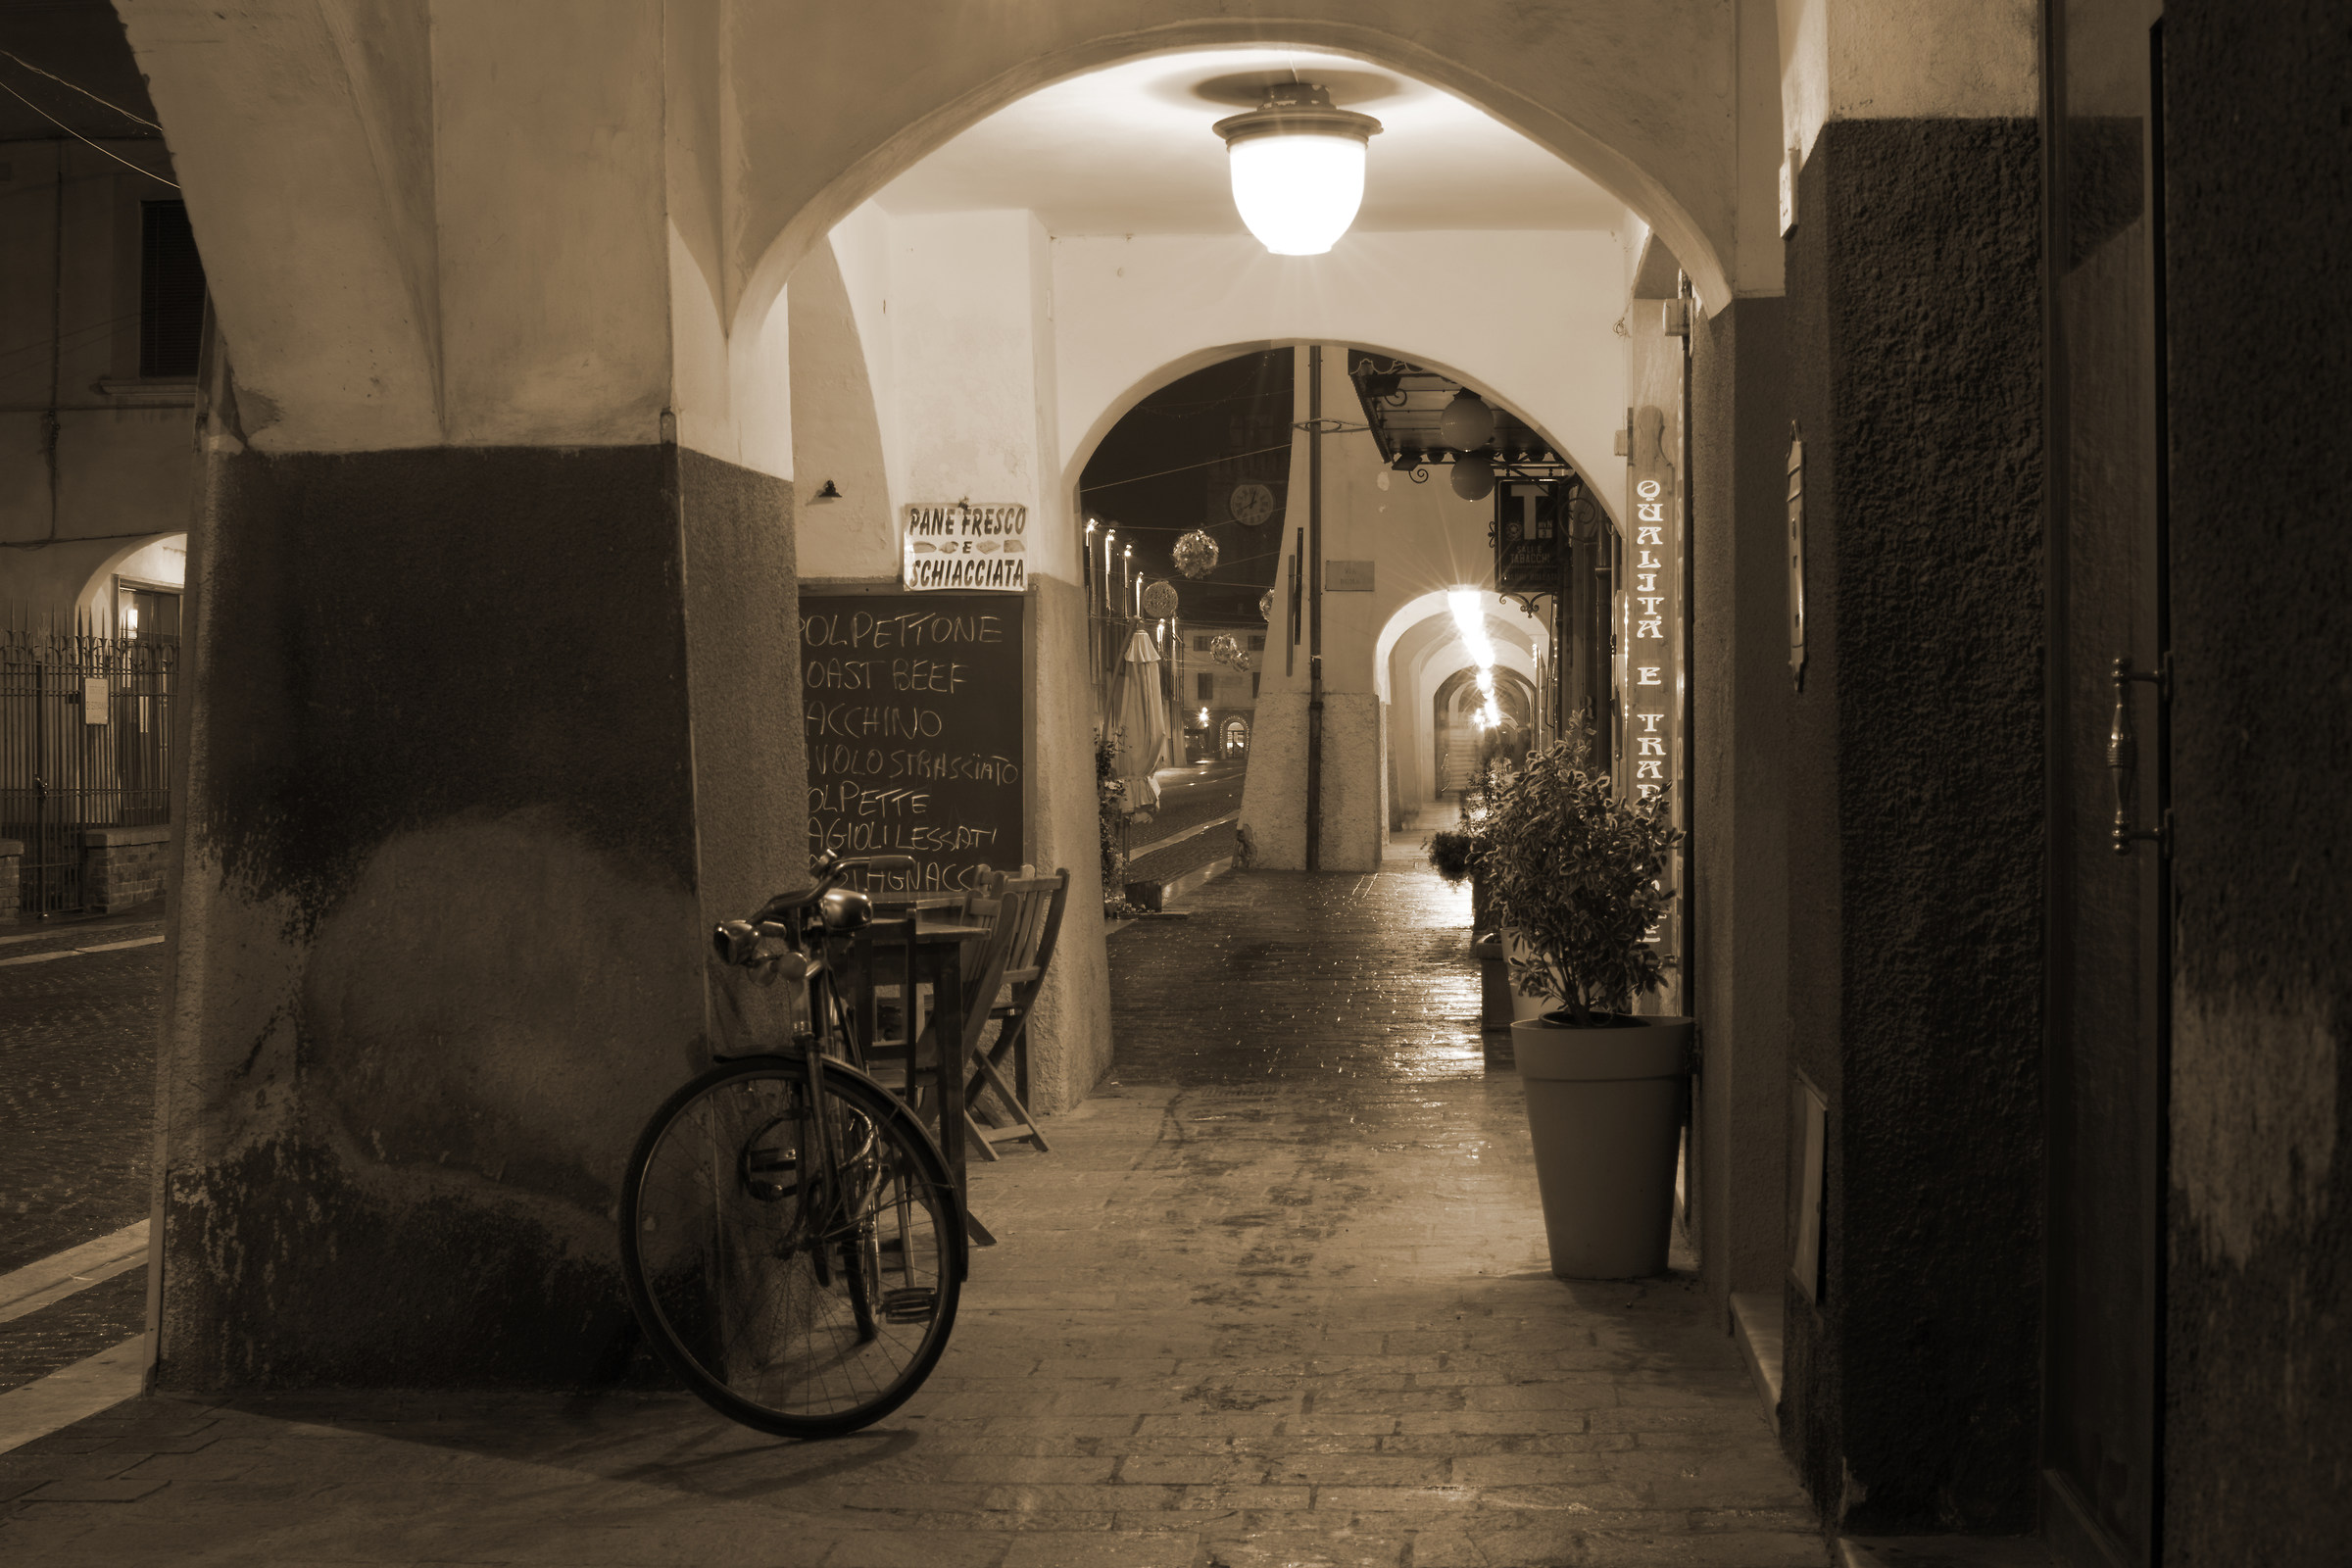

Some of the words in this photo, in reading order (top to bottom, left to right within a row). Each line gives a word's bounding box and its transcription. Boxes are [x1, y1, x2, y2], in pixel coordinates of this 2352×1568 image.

[909, 508, 956, 536] PANE
[961, 508, 1026, 537] FRESCO
[1510, 484, 1549, 540] T
[962, 541, 972, 554] E
[1510, 553, 1550, 564] TABACCHI
[909, 560, 1024, 587] SCHIACCIATA
[807, 658, 886, 690] OAST
[893, 658, 970, 694] BEEF
[1637, 666, 1662, 685] E
[804, 700, 943, 740] ACCHINO
[808, 780, 931, 818] OLPETTE
[808, 816, 888, 852] AGIOLI
